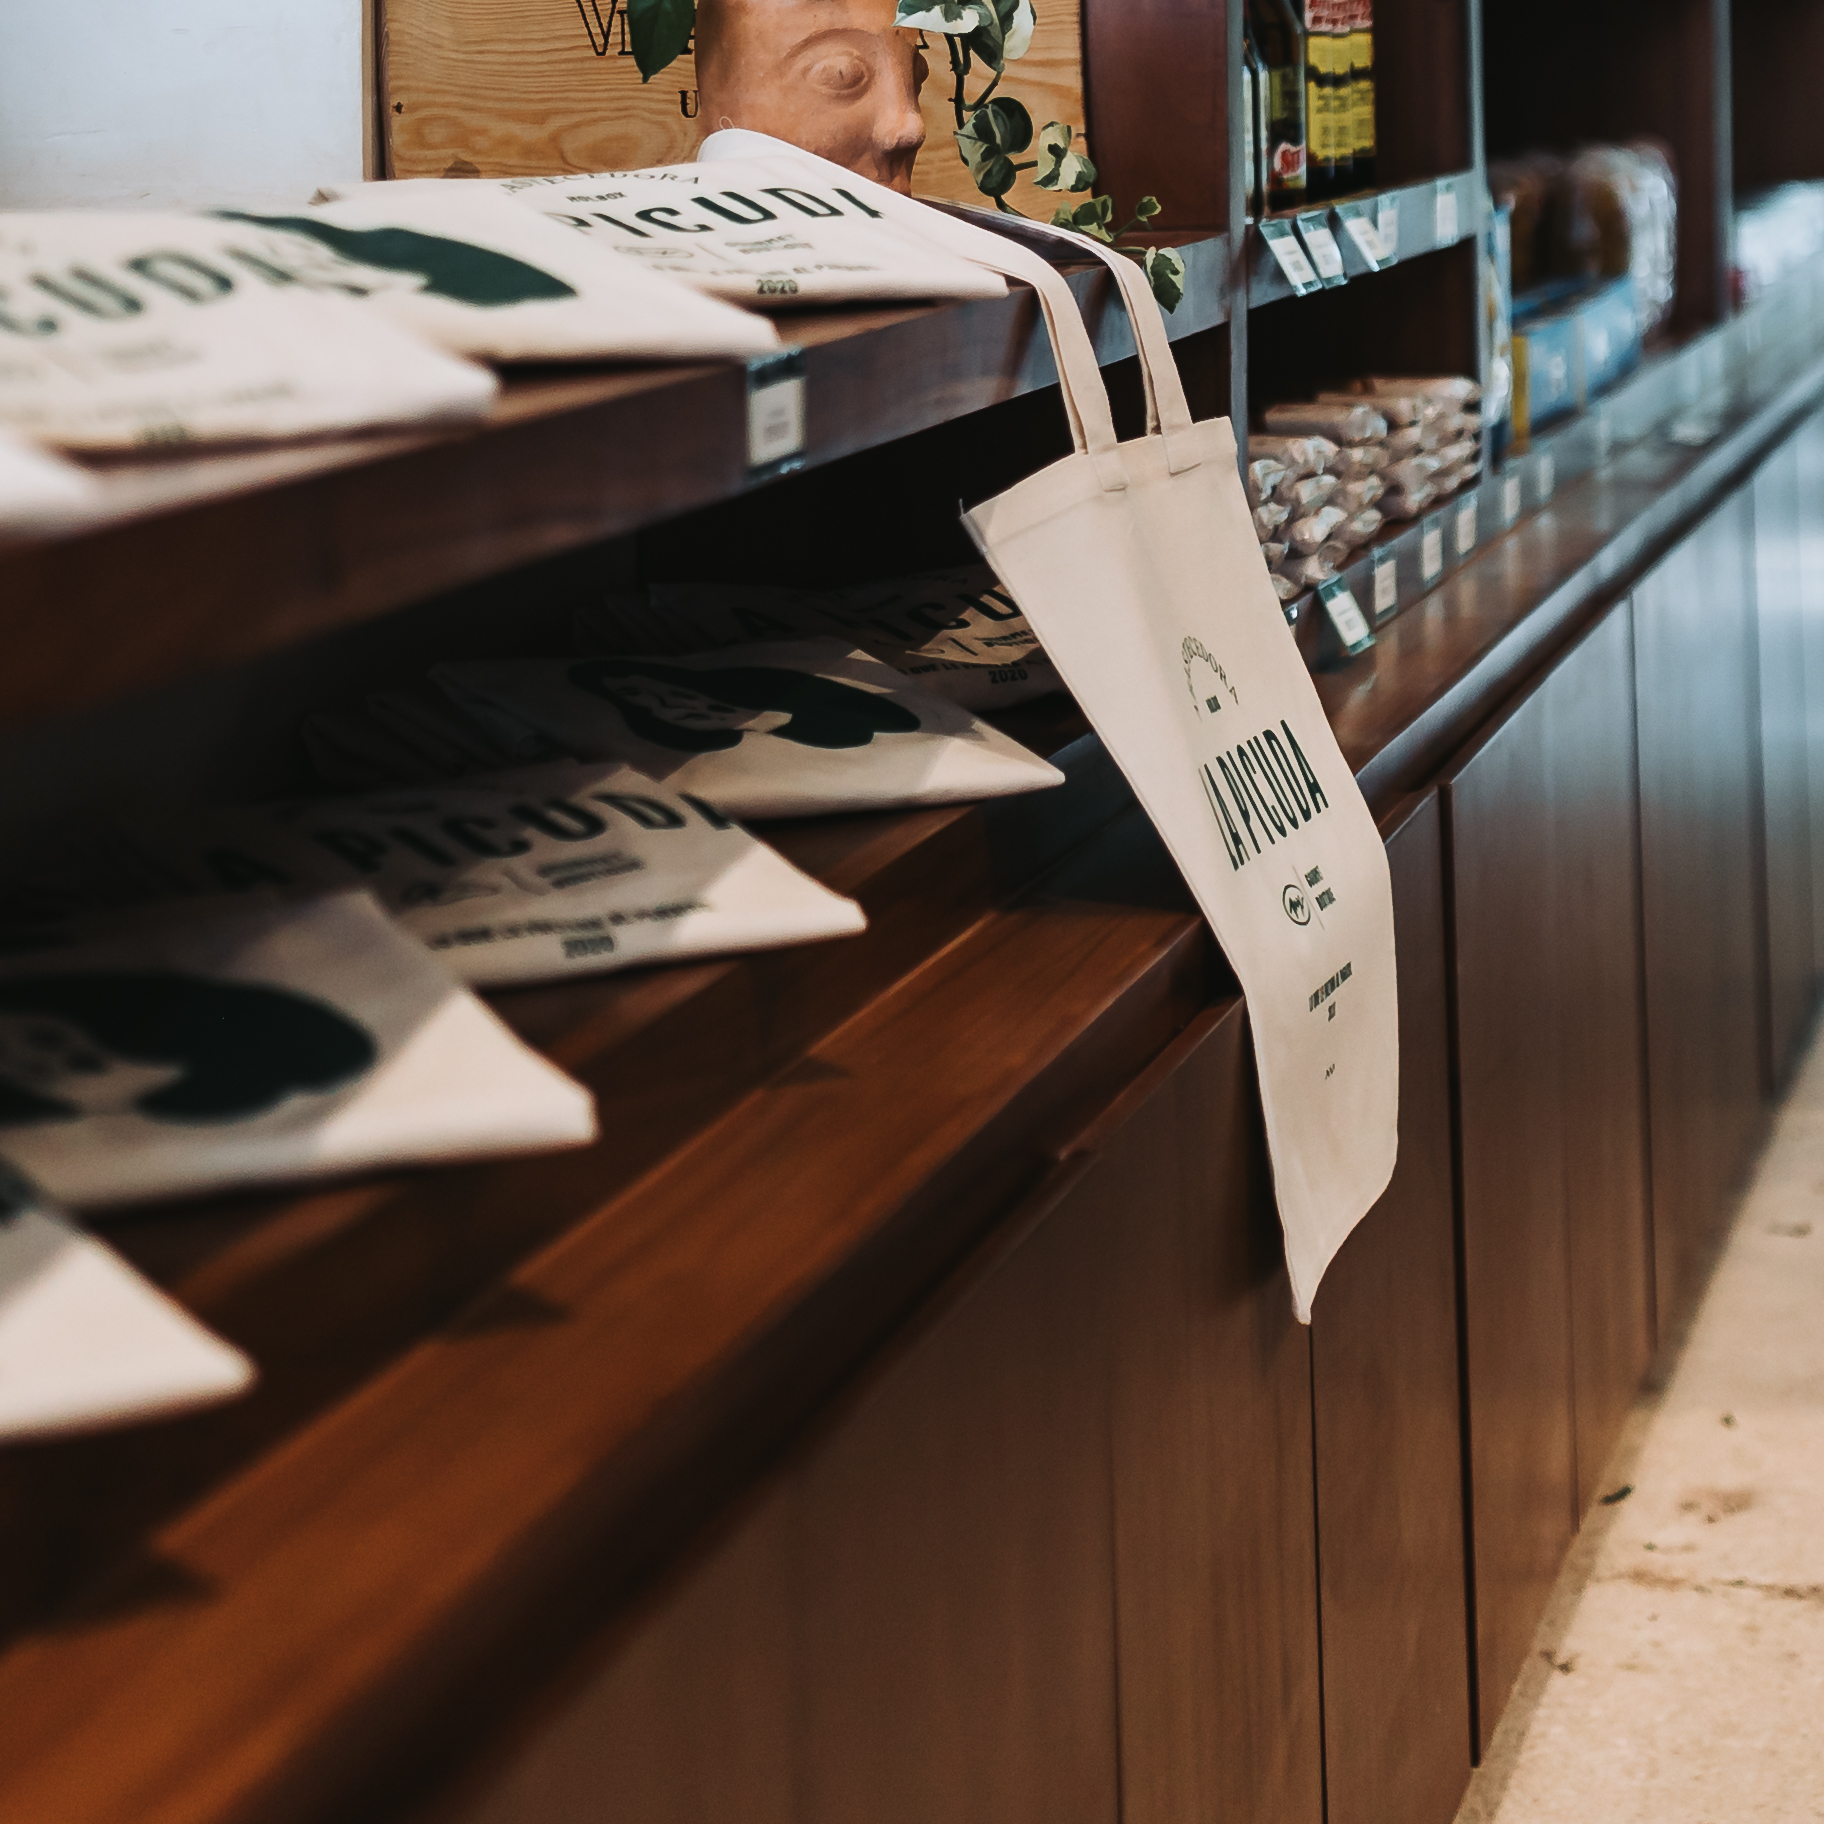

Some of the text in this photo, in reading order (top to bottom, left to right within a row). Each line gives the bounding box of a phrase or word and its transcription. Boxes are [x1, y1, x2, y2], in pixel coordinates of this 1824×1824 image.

[756, 279, 799, 295] 2020
[988, 669, 1028, 684] 2020
[1216, 719, 1330, 855] PICUDA
